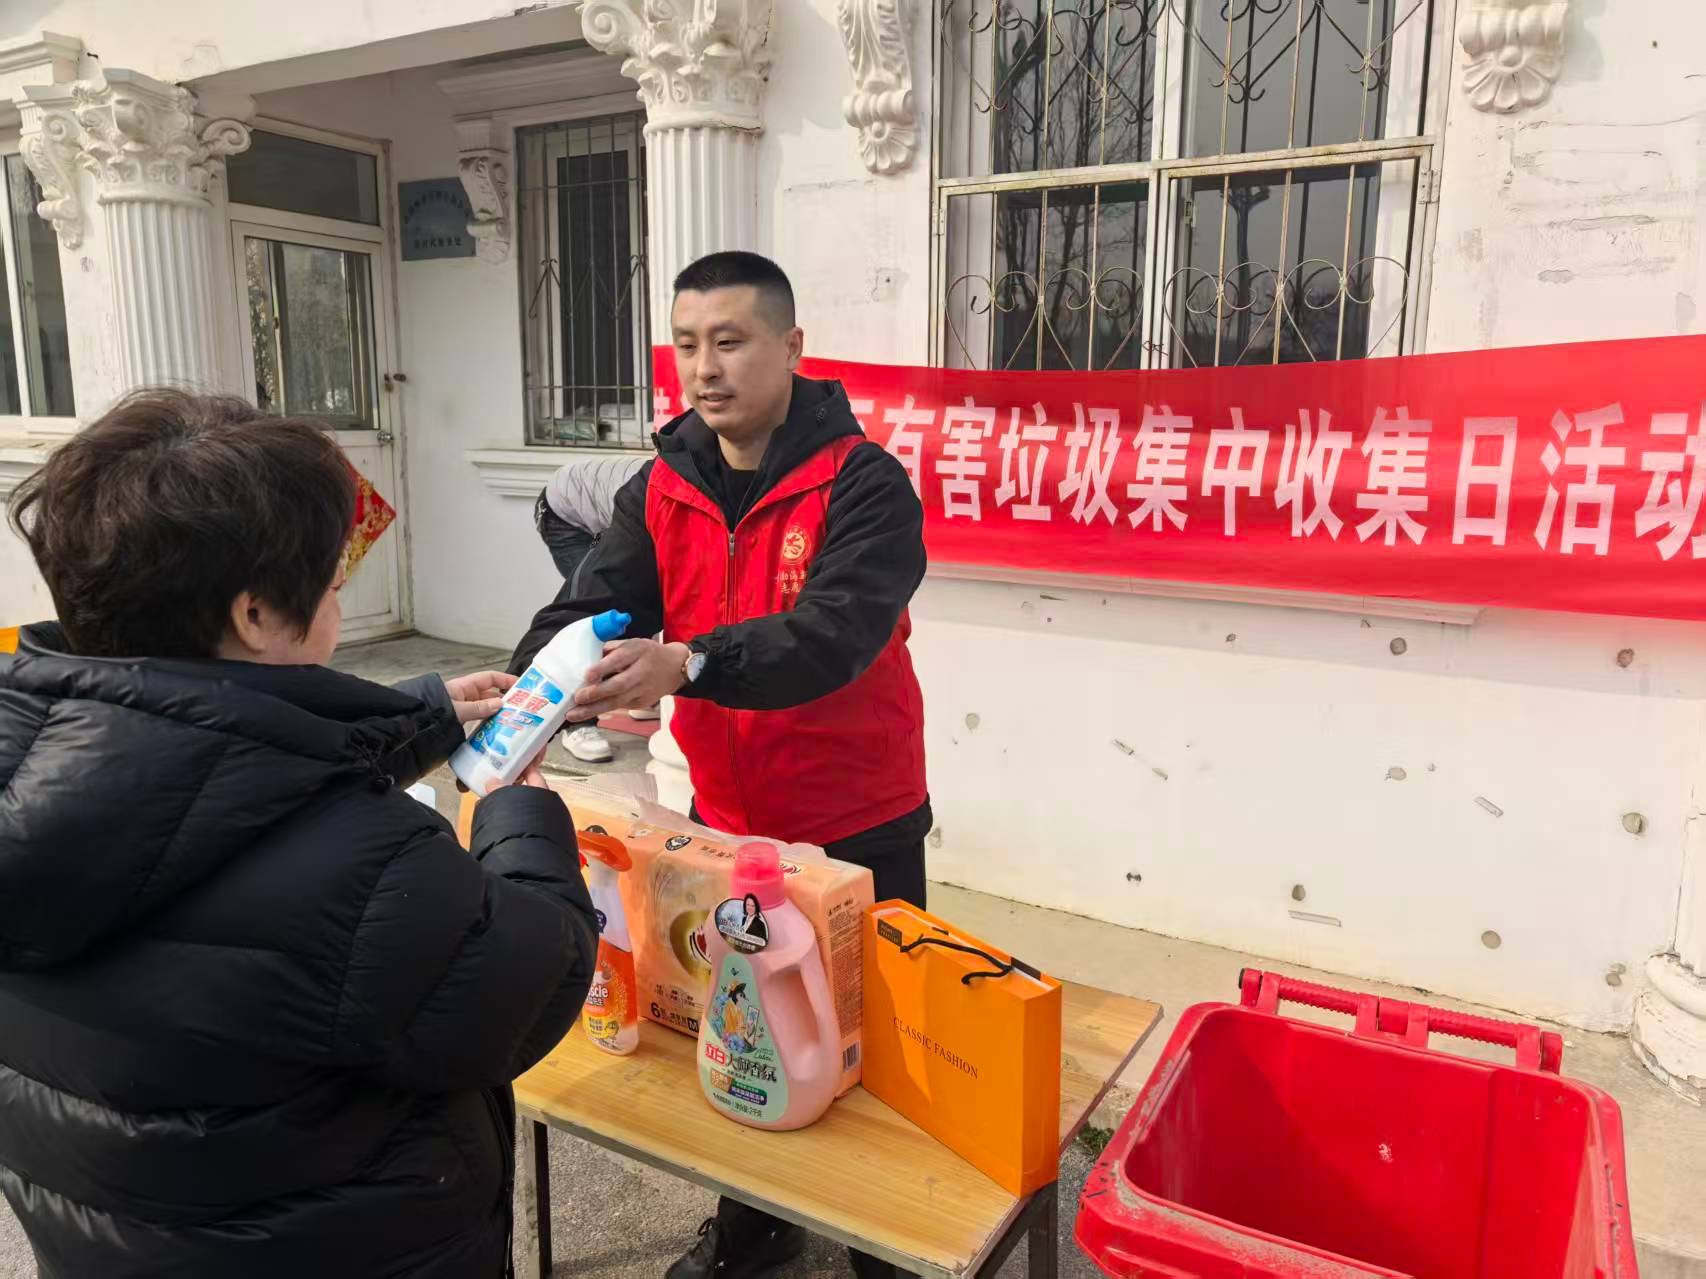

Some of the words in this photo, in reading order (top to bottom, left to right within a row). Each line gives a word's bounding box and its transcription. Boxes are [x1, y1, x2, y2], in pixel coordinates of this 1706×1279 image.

[850, 393, 1706, 561] 有害垃圾集中收集日活动
[587, 985, 609, 998] scle
[893, 1016, 932, 1051] CLASSIC
[934, 1044, 979, 1080] FASHION
